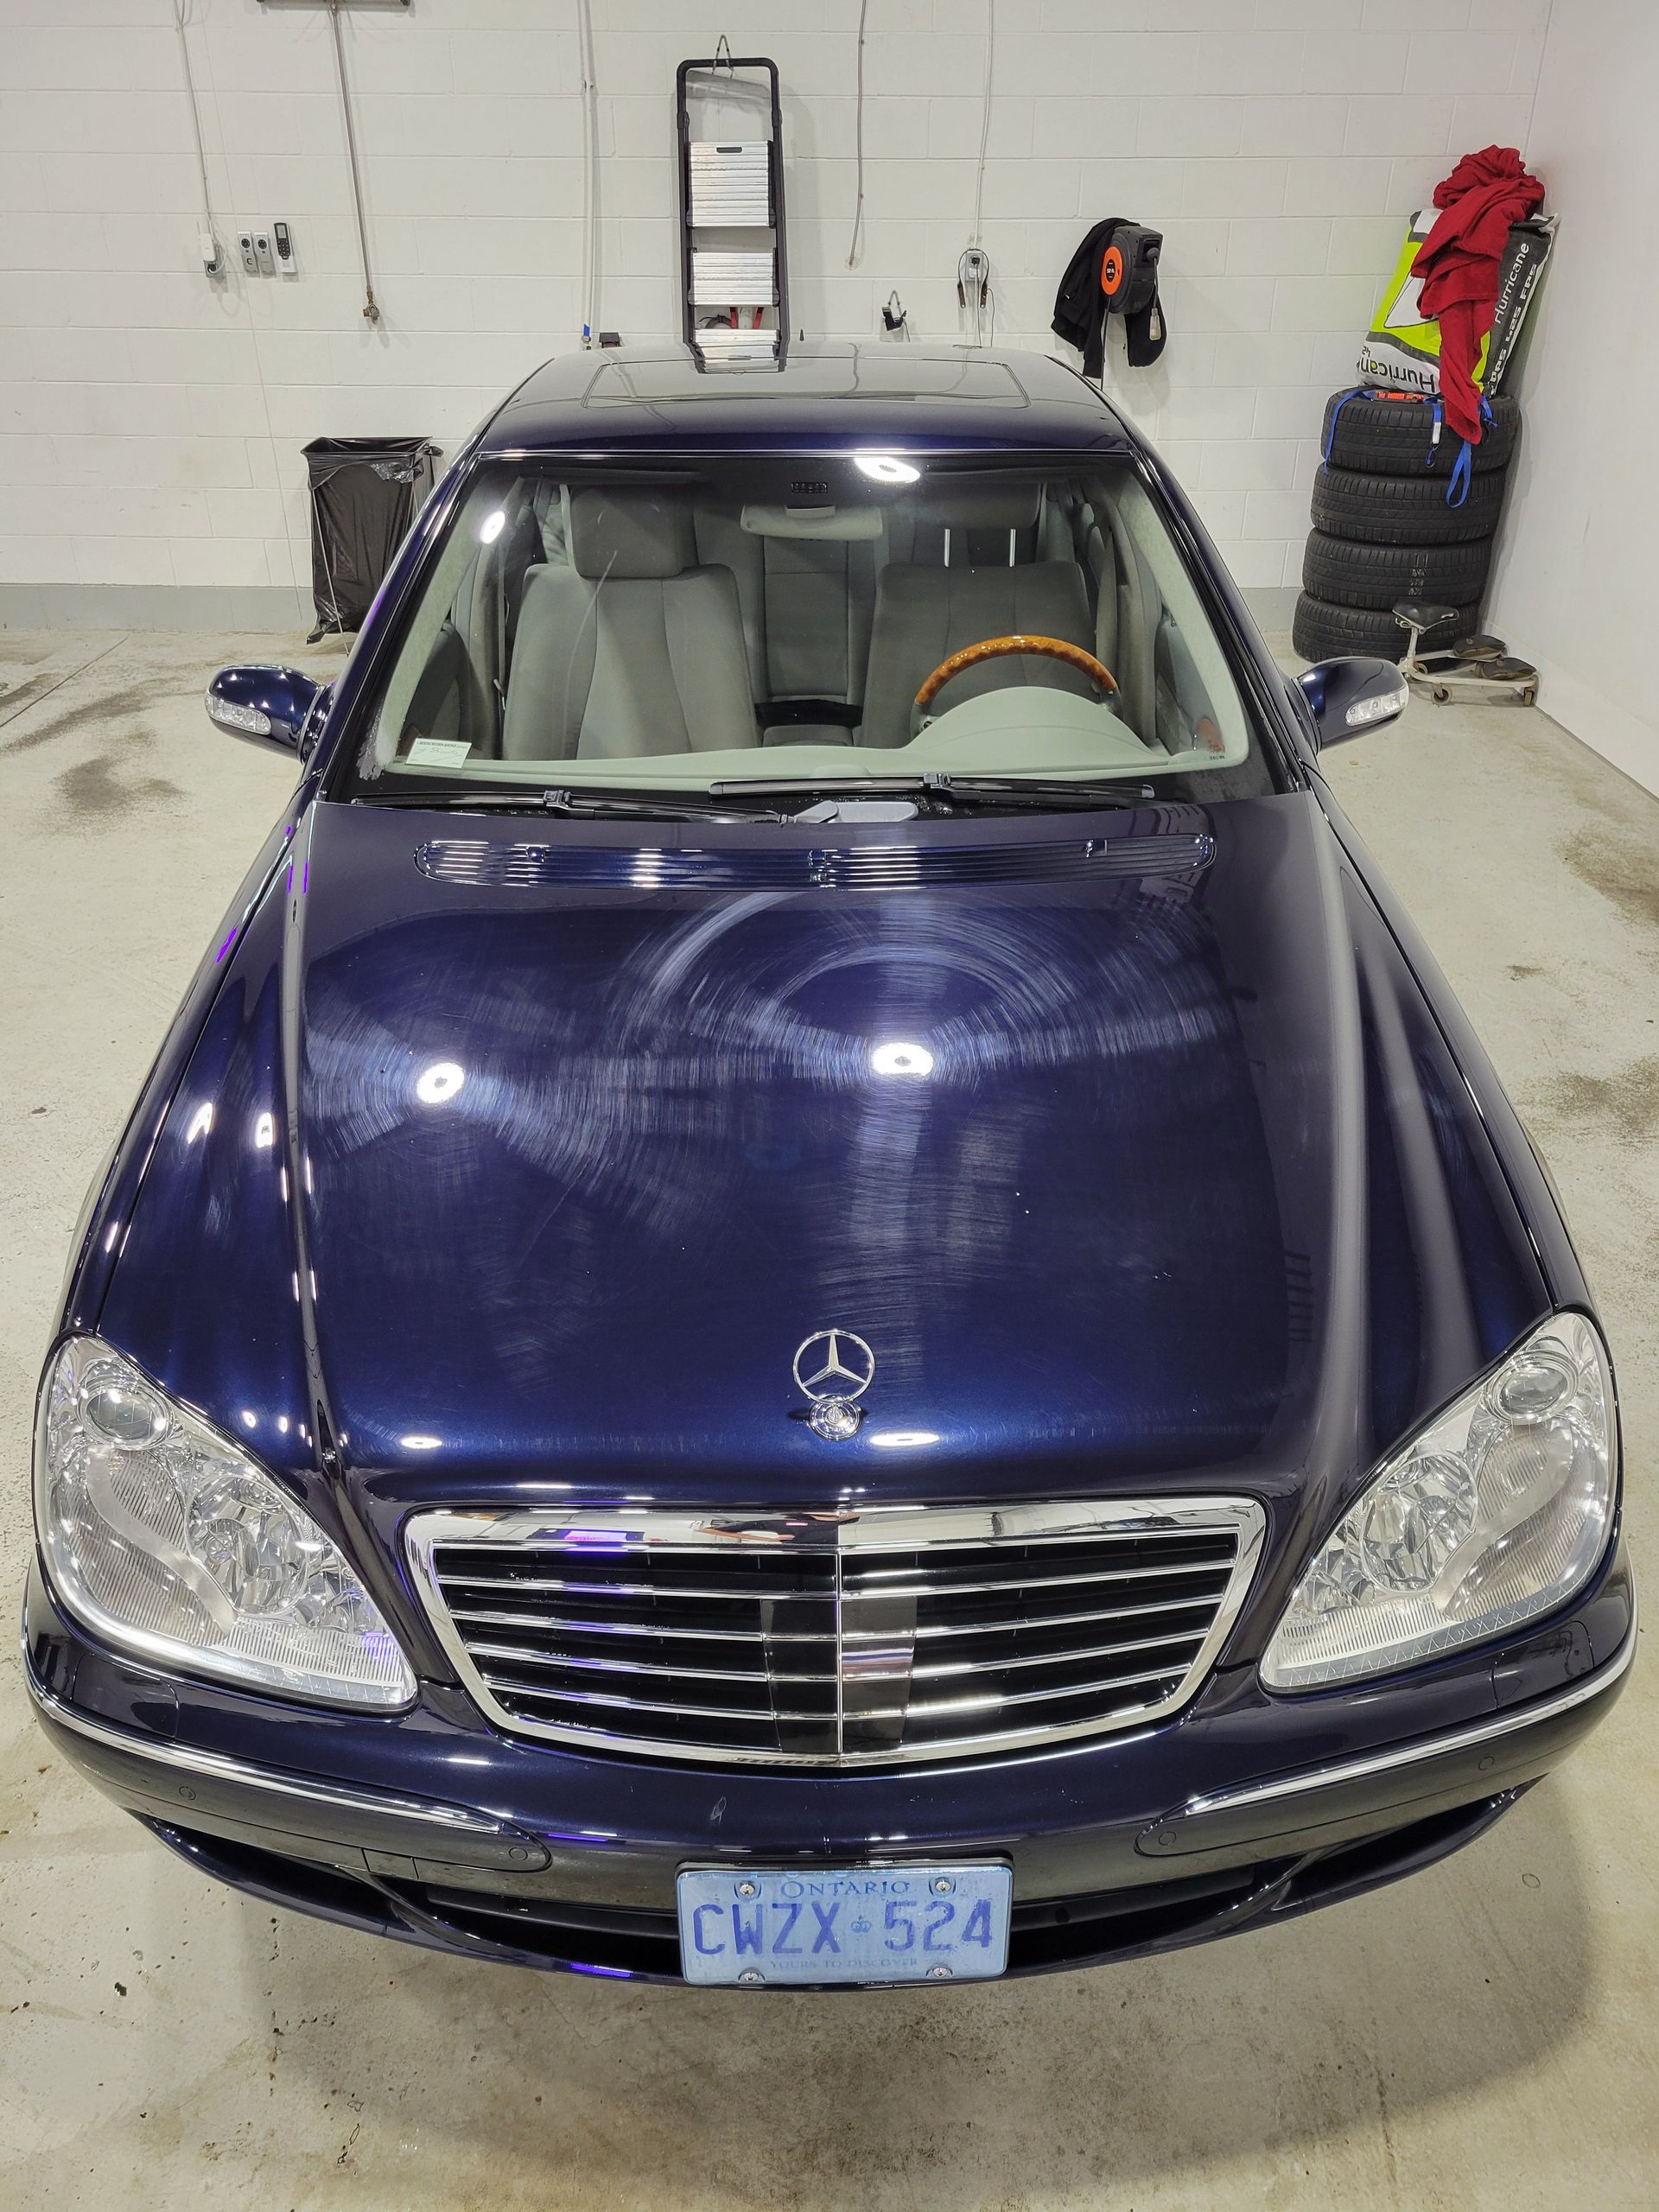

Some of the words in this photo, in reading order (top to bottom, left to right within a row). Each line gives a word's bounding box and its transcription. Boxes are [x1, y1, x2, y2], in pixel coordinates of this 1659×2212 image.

[1494, 243, 1529, 324] Hurricane
[1520, 264, 1537, 301] FPS
[780, 1880, 911, 1898] ONTARIO
[692, 1902, 842, 1955] CWZX
[884, 1899, 994, 1953] 524
[770, 1959, 817, 1968] YOURS
[823, 1959, 842, 1967] TO
[848, 1957, 918, 1967] DISCOVER
